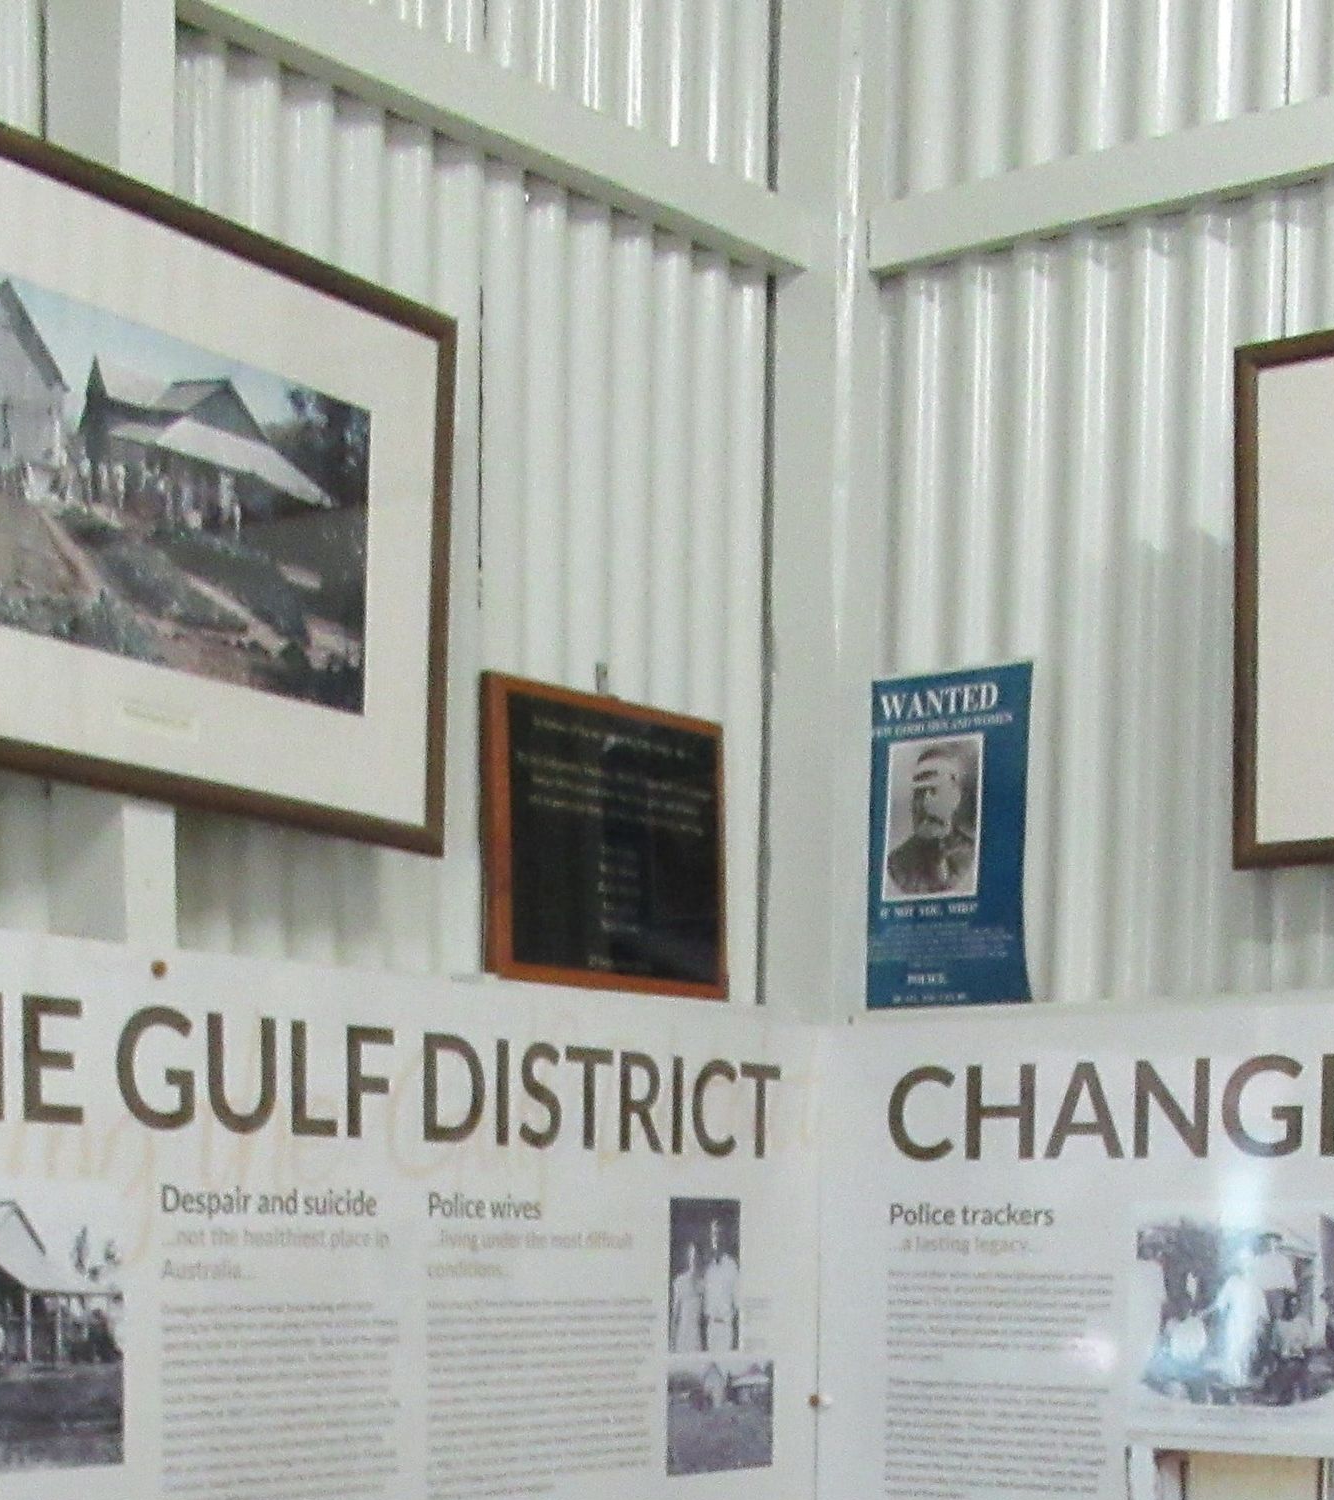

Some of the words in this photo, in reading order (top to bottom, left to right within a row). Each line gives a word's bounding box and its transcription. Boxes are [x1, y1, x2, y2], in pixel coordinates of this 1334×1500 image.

[880, 681, 999, 720] WANTED
[117, 1005, 394, 1138] GULF
[423, 1031, 781, 1158] DISTRICT
[161, 1184, 251, 1219] Despair
[257, 1189, 298, 1216] and
[304, 1189, 377, 1217] suicide
[427, 1190, 485, 1219] Police
[490, 1192, 542, 1220] wives
[889, 1202, 956, 1227] Police
[961, 1202, 1055, 1227] trackers
[211, 1229, 238, 1247] the
[243, 1228, 325, 1248] healthiest
[331, 1230, 369, 1250] place
[915, 1235, 969, 1256] lasting
